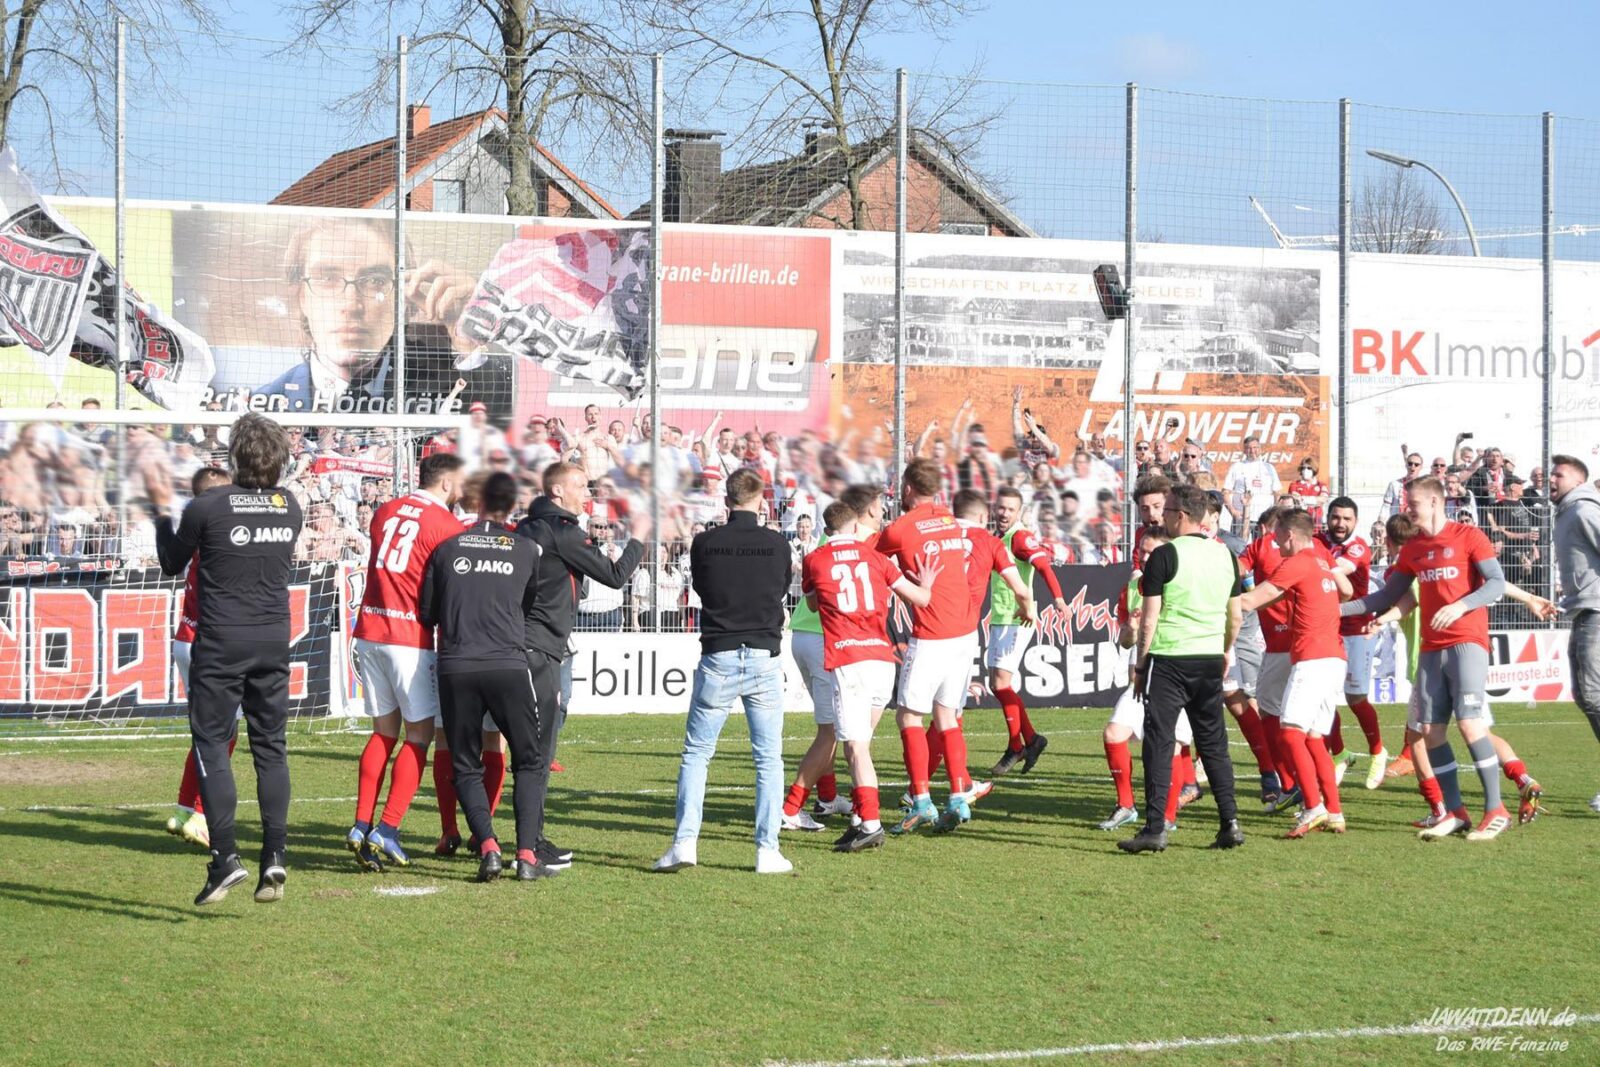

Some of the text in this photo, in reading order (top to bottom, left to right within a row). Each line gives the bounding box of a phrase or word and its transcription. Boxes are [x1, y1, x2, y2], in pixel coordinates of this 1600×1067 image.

[659, 262, 799, 286] rane-brillen.de
[1019, 280, 1078, 295] PLATZ
[1077, 408, 1301, 445] LANDWEHR
[253, 527, 293, 542] JAKO
[376, 516, 420, 573] 13
[474, 559, 514, 575] JAKO
[831, 562, 876, 613] 31
